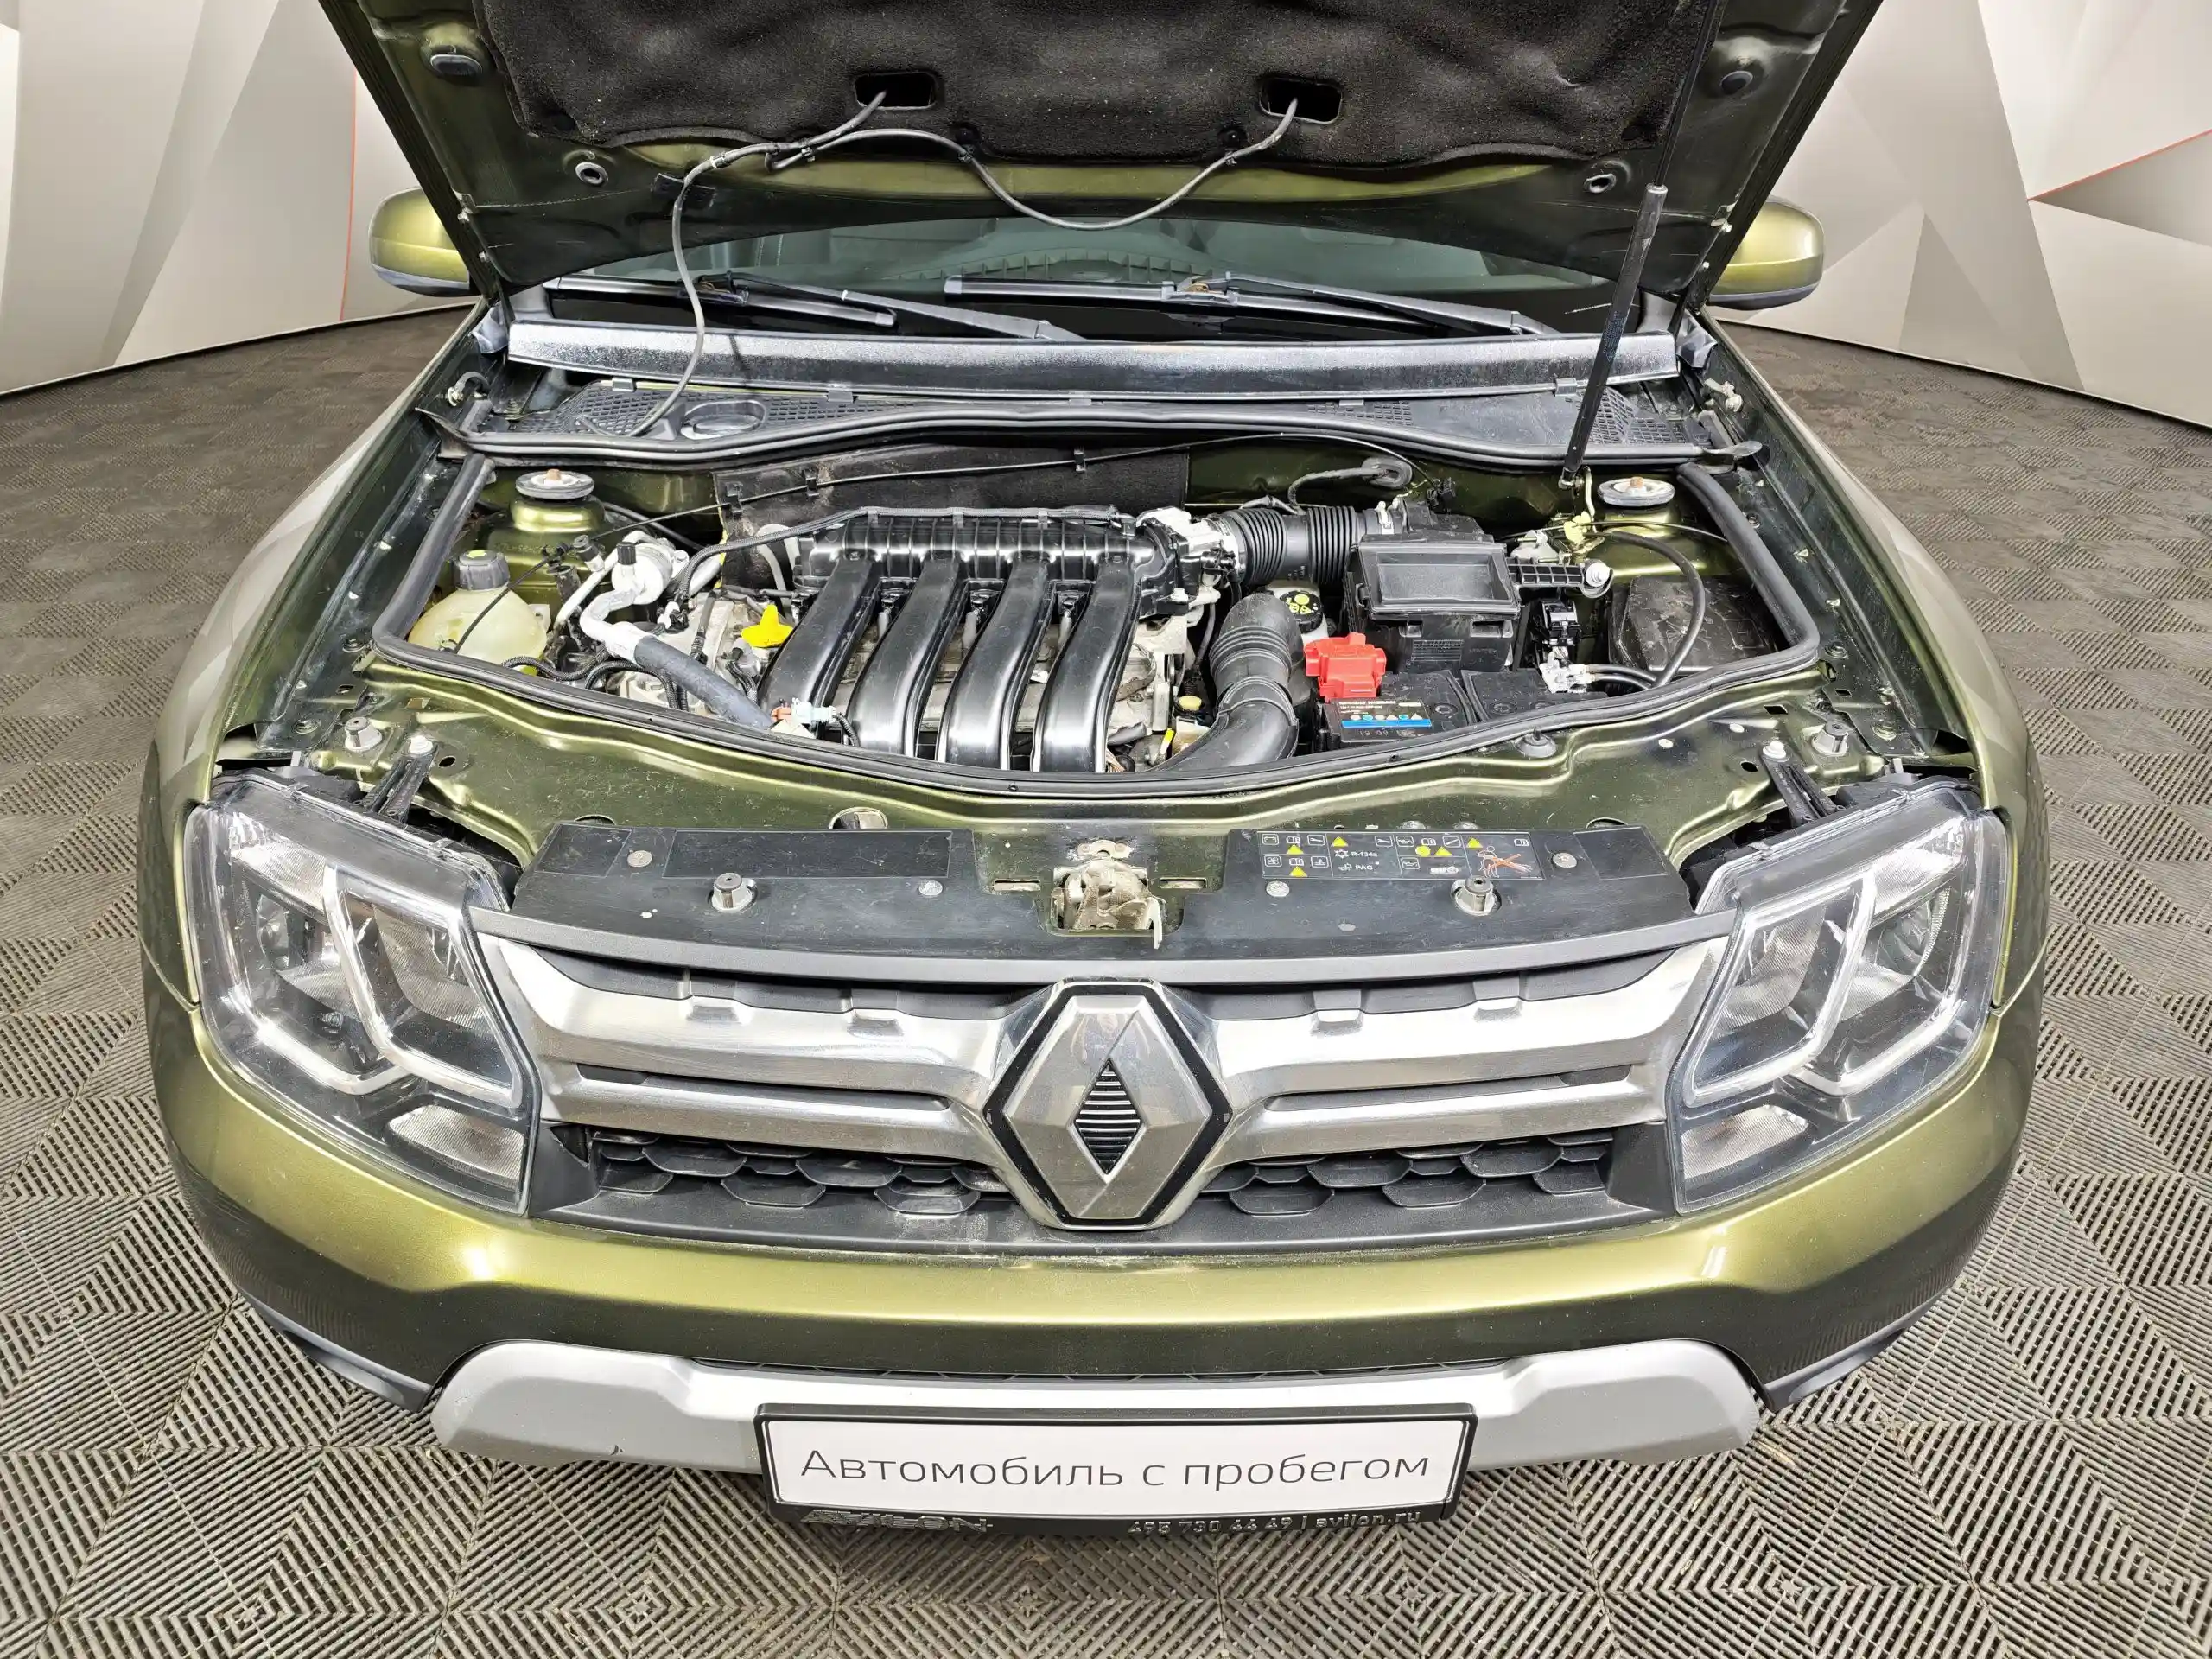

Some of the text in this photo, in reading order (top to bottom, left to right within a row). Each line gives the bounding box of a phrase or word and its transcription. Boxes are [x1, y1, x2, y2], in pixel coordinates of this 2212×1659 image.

[800, 1449, 1429, 1491] Автомобиль с пробегом
[1128, 1520, 1171, 1534] 495
[1179, 1519, 1221, 1533] 730
[1265, 1516, 1293, 1530] 49
[1316, 1510, 1421, 1529] avilon.ru
